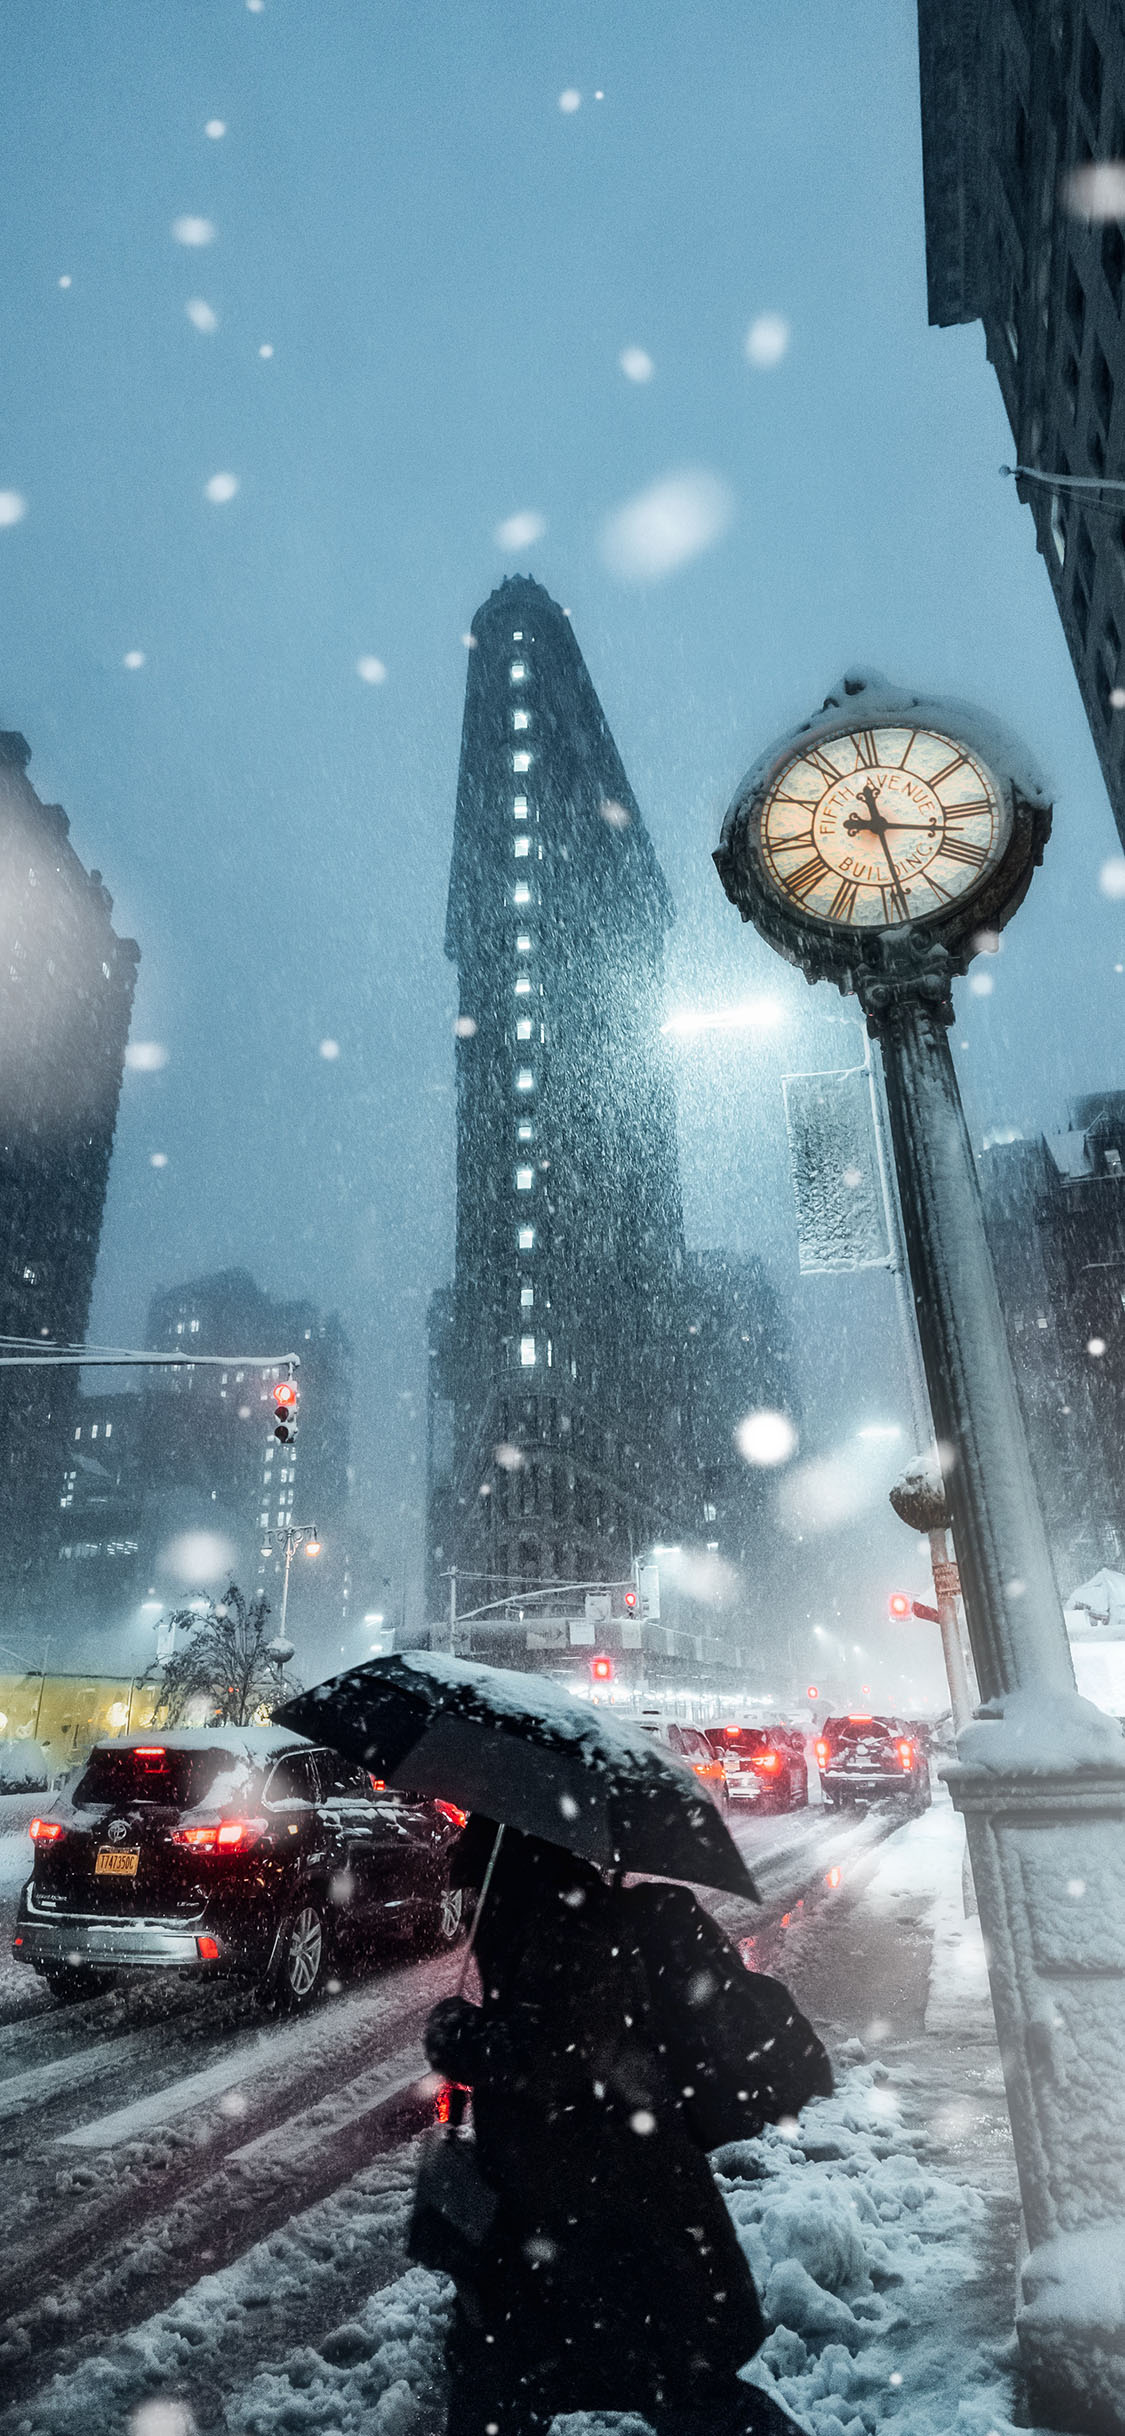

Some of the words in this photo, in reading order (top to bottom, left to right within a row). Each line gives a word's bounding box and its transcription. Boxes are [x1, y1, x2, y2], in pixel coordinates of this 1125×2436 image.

[851, 731, 879, 770] XII
[803, 748, 844, 788] XI
[926, 754, 970, 788] II
[772, 789, 818, 813] X
[820, 786, 855, 834] FIFTH
[866, 774, 936, 815] AVENUE
[944, 799, 992, 819] III
[766, 831, 815, 853] IX
[937, 836, 992, 868] IIII
[838, 841, 933, 882] BUILDING
[783, 856, 831, 902] VIII
[920, 871, 956, 905] V
[828, 879, 859, 923] VII
[100, 1855, 135, 1870] T747350C
